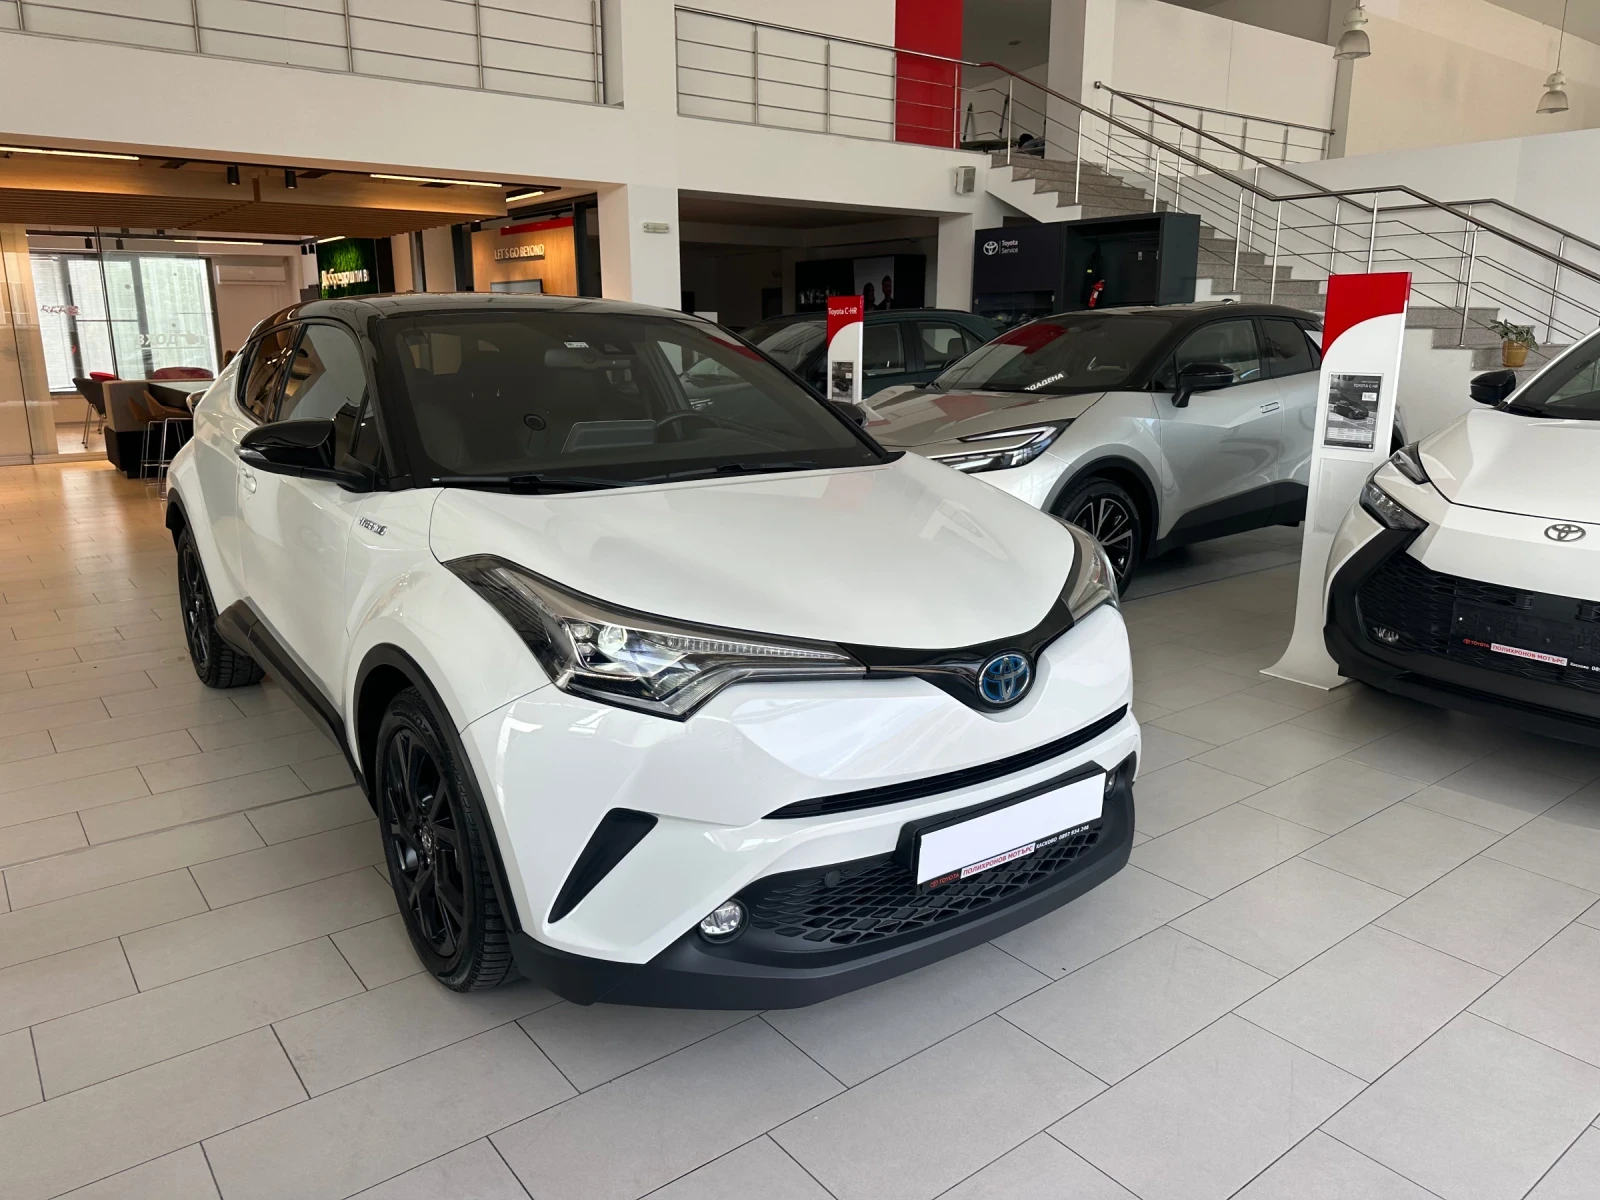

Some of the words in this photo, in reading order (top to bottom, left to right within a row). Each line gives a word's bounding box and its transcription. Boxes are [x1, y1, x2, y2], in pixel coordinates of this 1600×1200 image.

[510, 247, 519, 258] GO
[520, 244, 545, 257] BEYOND
[828, 308, 844, 316] Toyota
[845, 307, 857, 315] C-HR
[1470, 640, 1490, 648] TOYOTA
[1492, 645, 1536, 659] ПОЛИХРОНОВ
[1537, 654, 1565, 665] МОТЪРС
[963, 855, 1007, 876] ПОЛИХРОНОВ
[1007, 845, 1034, 860] МОТЪРС
[938, 873, 959, 884] TOYOTA
